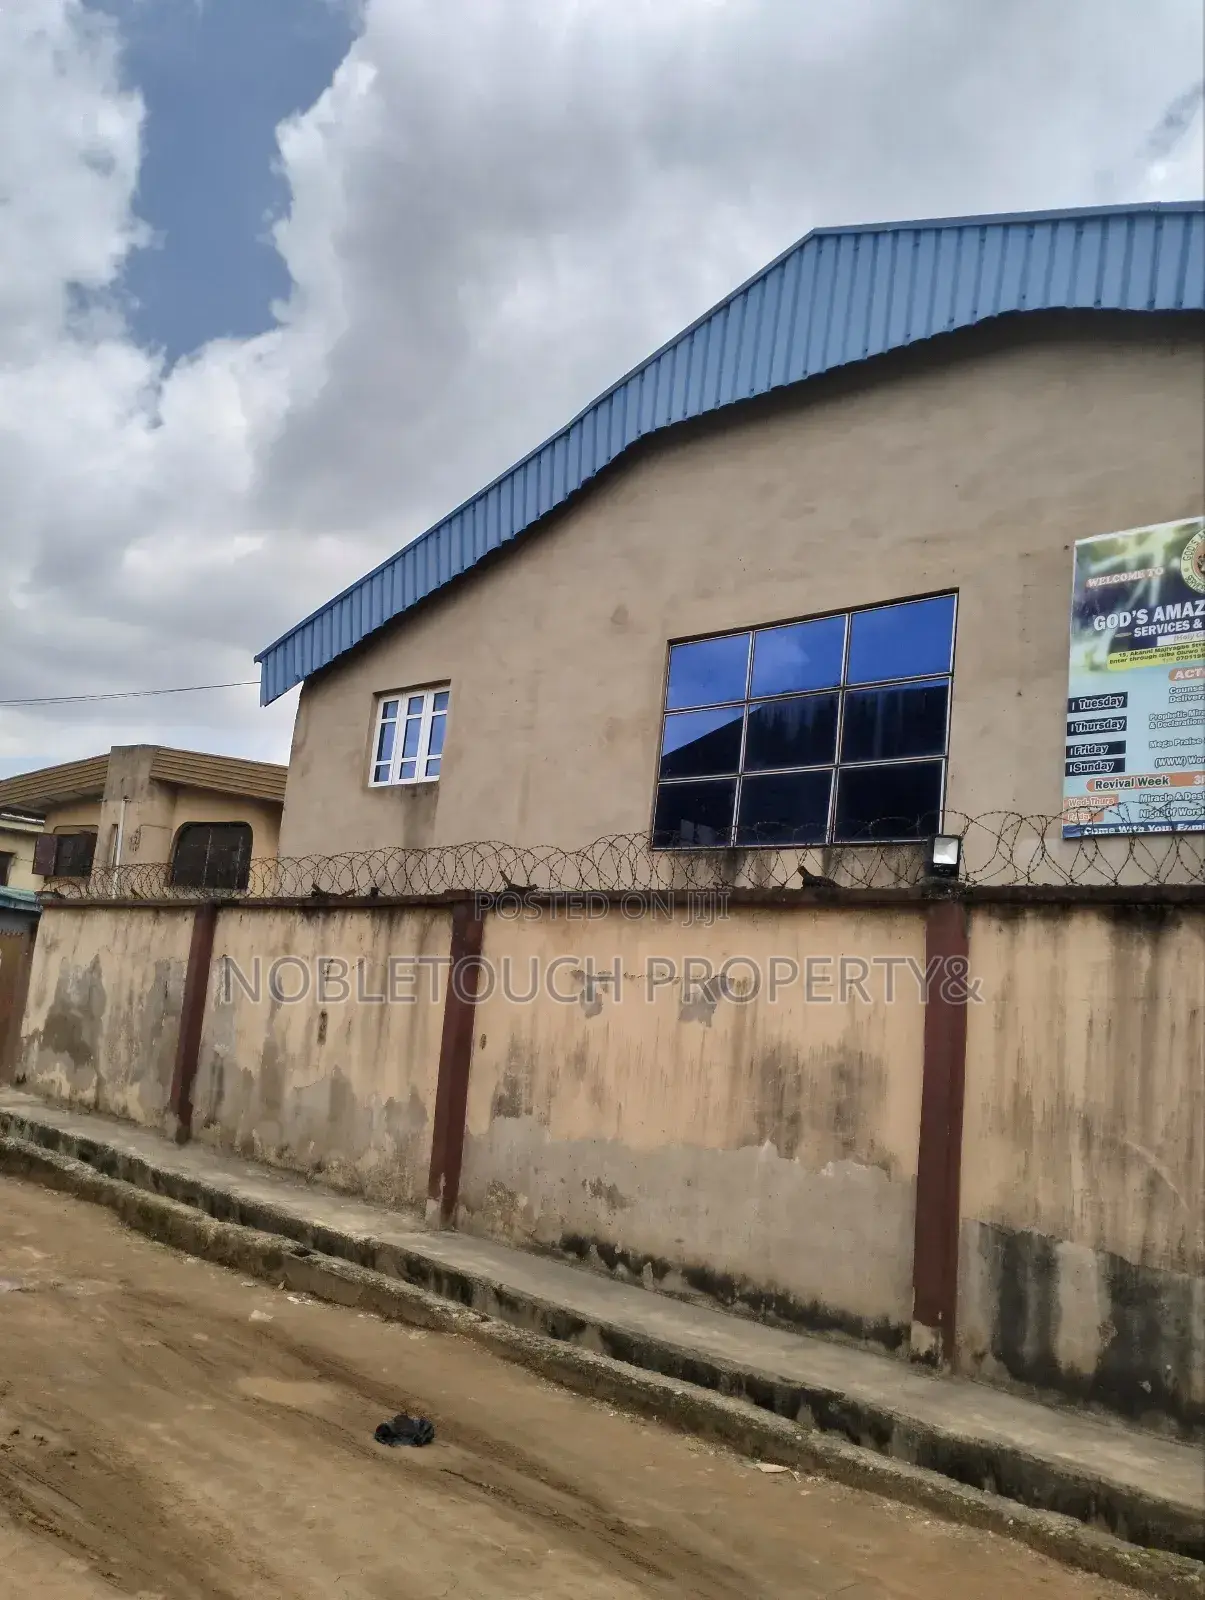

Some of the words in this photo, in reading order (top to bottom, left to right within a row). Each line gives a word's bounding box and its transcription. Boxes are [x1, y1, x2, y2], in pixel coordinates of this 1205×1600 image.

[1086, 572, 1145, 588] WELCOME
[1147, 566, 1165, 579] TO
[1094, 608, 1149, 631] GOD'S
[1153, 600, 1205, 622] AMAZ
[1134, 620, 1190, 637] SERVICES
[1193, 618, 1203, 629] &
[1079, 695, 1124, 710] Tuesday
[1149, 711, 1188, 721] Prophetic
[1075, 719, 1125, 733] Thursday
[1149, 721, 1156, 729] &
[1174, 737, 1202, 746] Praise
[1074, 744, 1109, 756] Friday
[1073, 760, 1114, 773] Sunday
[1155, 756, 1187, 768] (WWW)
[1095, 778, 1135, 791] Revival
[1137, 775, 1170, 787] Week
[1139, 793, 1173, 802] Miracle
[1175, 792, 1182, 800] &
